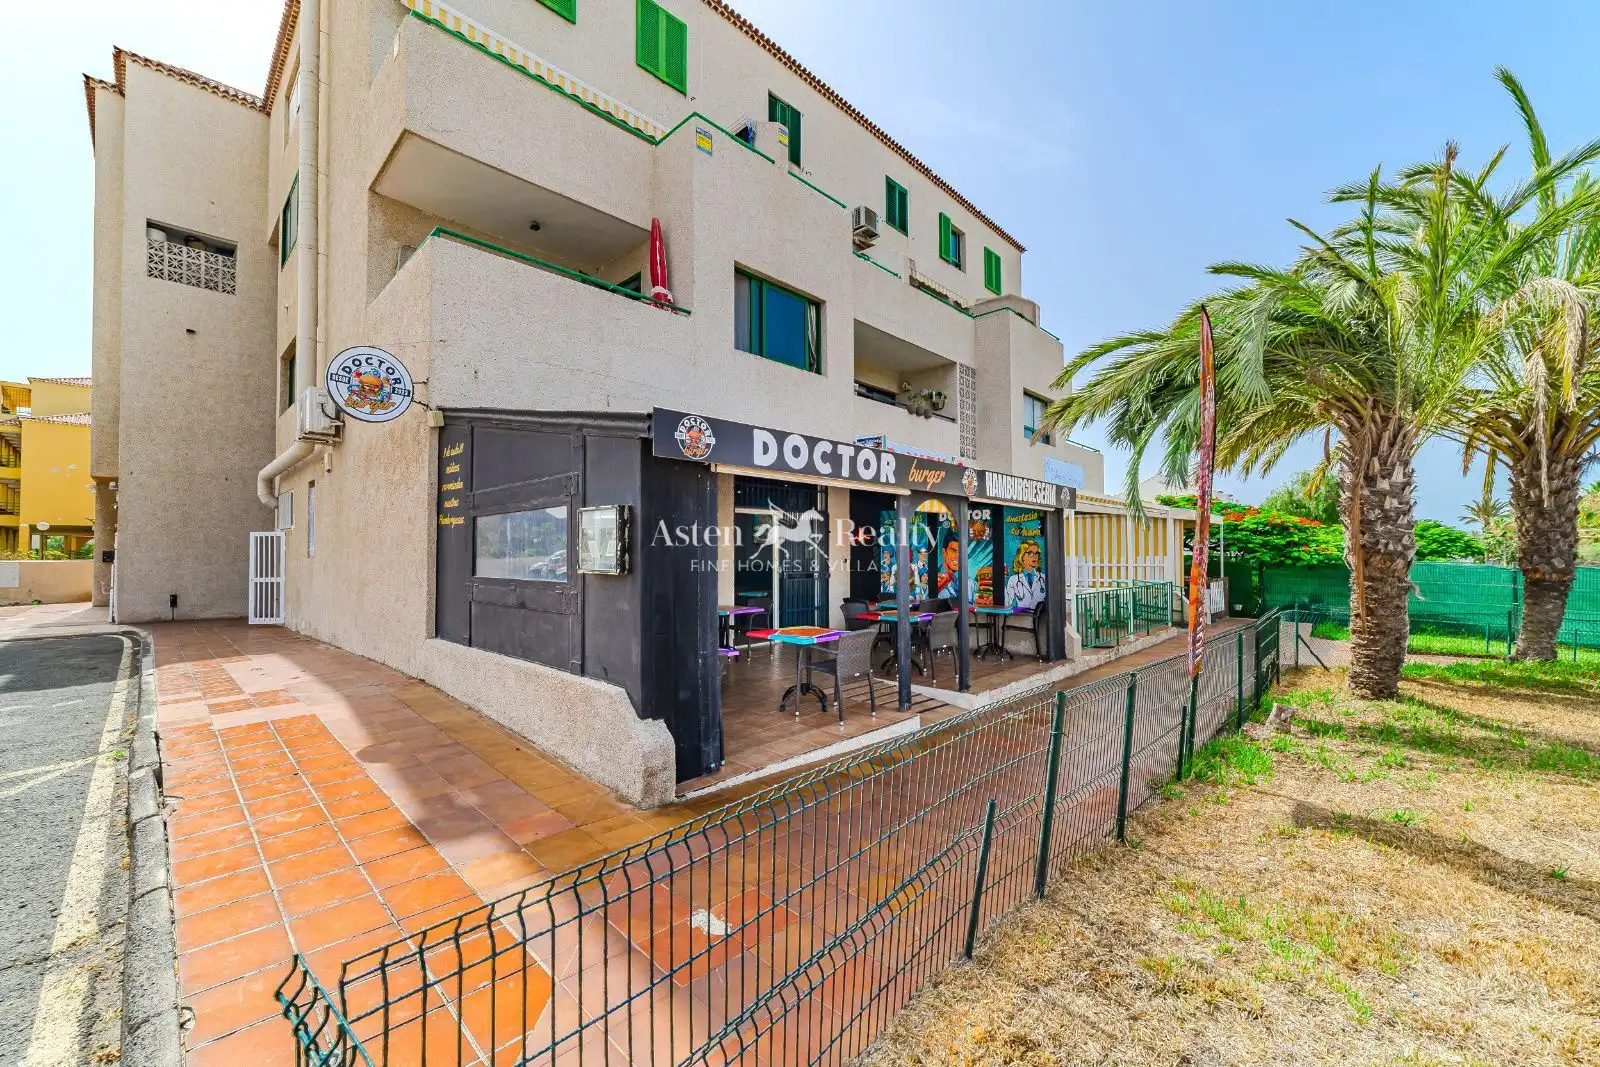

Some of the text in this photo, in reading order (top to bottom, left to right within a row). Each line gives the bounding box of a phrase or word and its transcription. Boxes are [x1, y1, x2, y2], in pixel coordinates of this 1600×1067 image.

[341, 357, 402, 385] DOCTOR
[344, 393, 396, 415] burger
[680, 418, 710, 436] DOCTOR
[753, 428, 897, 484] DOCTOR
[908, 459, 946, 491] burger
